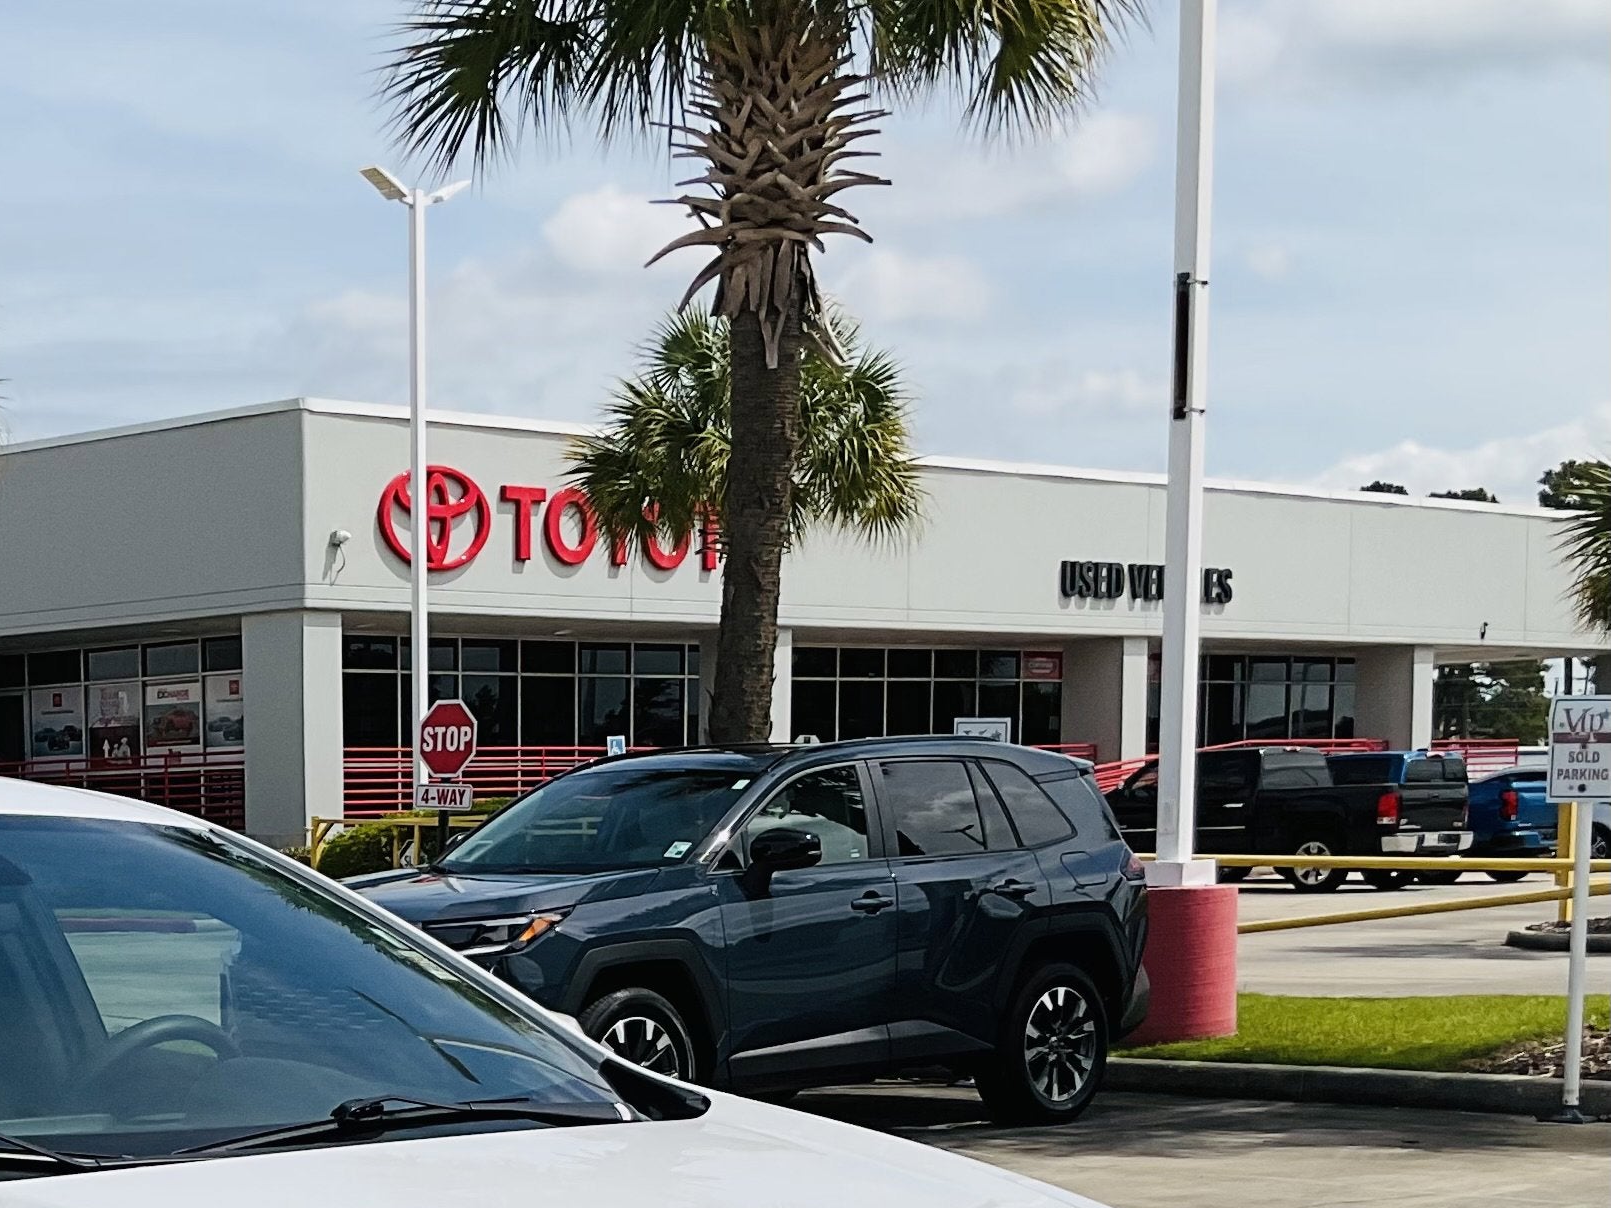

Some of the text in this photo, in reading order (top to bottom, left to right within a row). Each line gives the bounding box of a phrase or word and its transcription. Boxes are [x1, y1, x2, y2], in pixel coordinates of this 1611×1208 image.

[1060, 561, 1233, 604] USED VEES
[422, 725, 472, 752] STOP
[1568, 751, 1600, 763] SOLD
[1557, 768, 1609, 780] PARKING
[420, 788, 466, 805] 4-WAY
